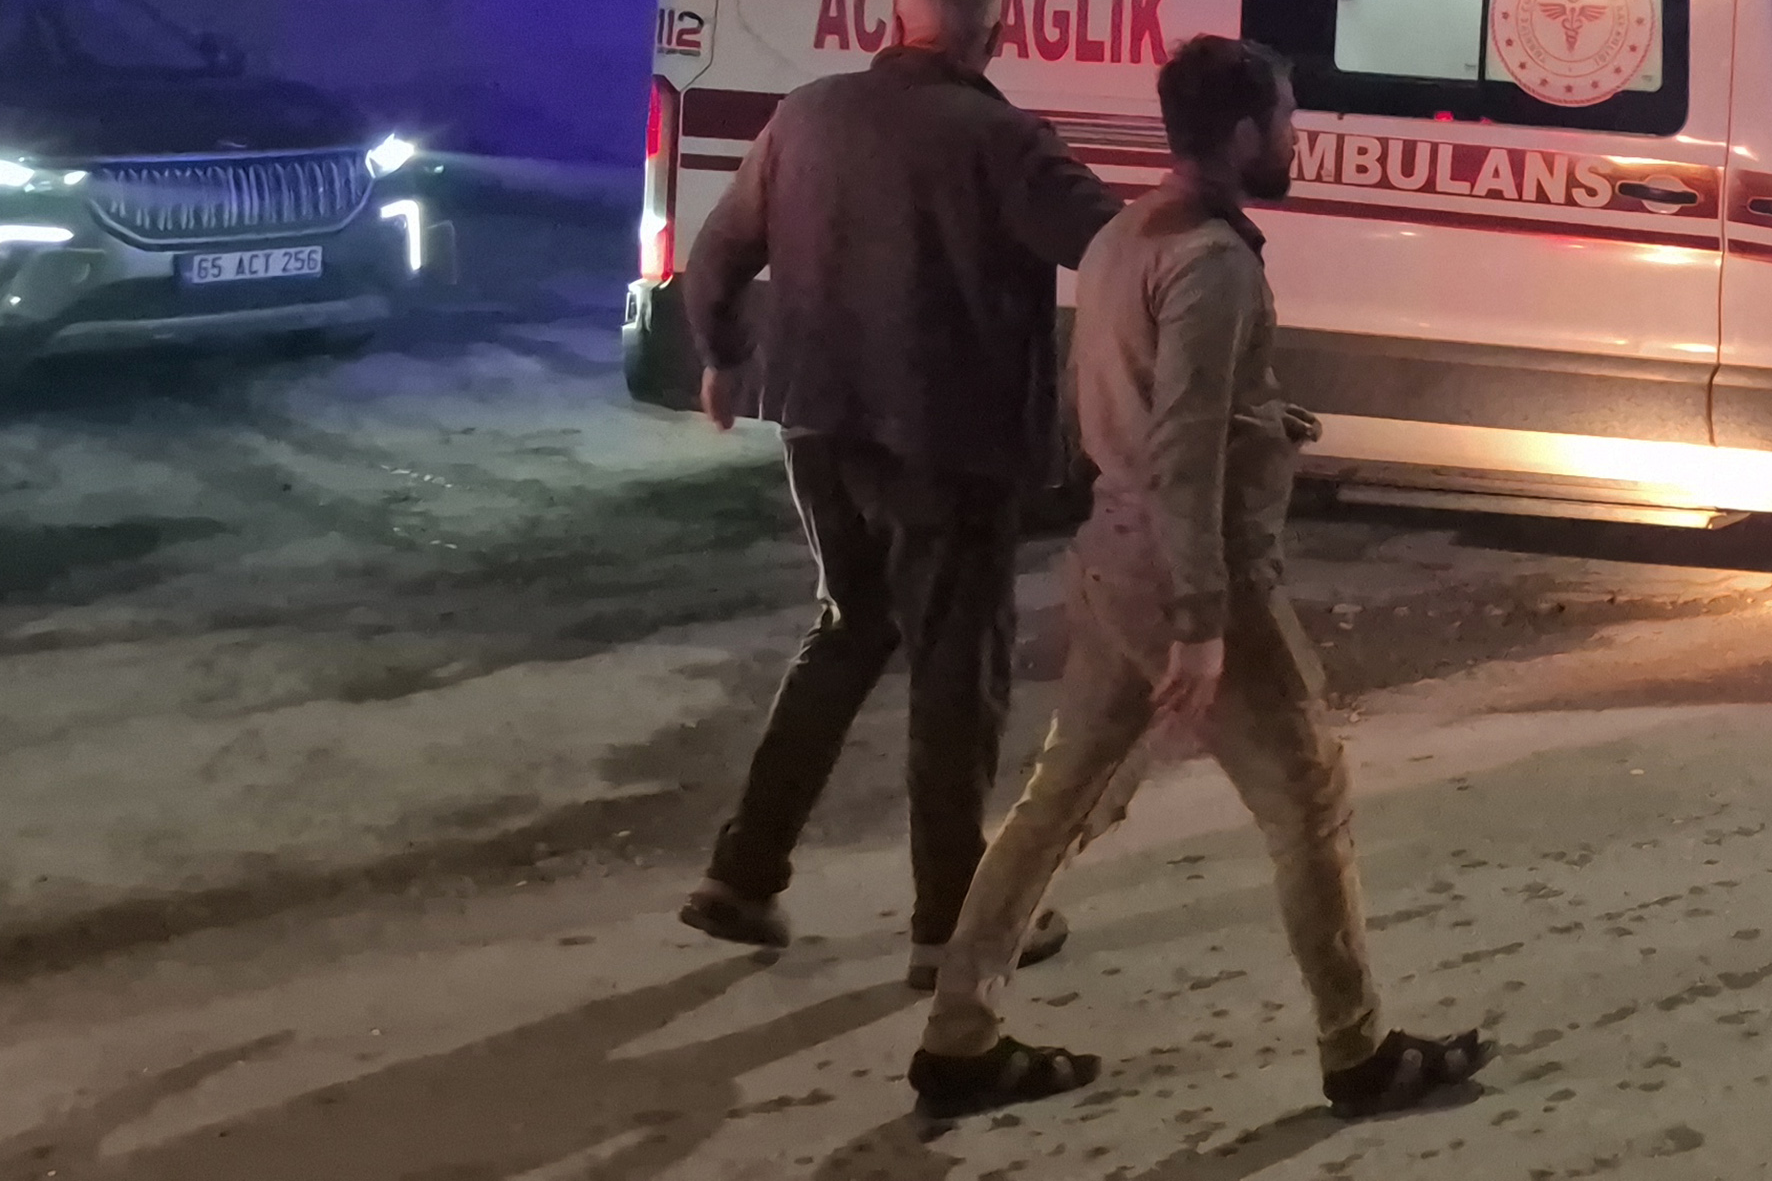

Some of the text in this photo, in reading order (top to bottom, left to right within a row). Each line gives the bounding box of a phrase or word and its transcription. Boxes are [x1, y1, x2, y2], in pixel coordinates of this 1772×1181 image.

[657, 8, 704, 49] 112
[1291, 132, 1612, 208] MBULANS
[197, 249, 319, 279] 65 ACT 256
